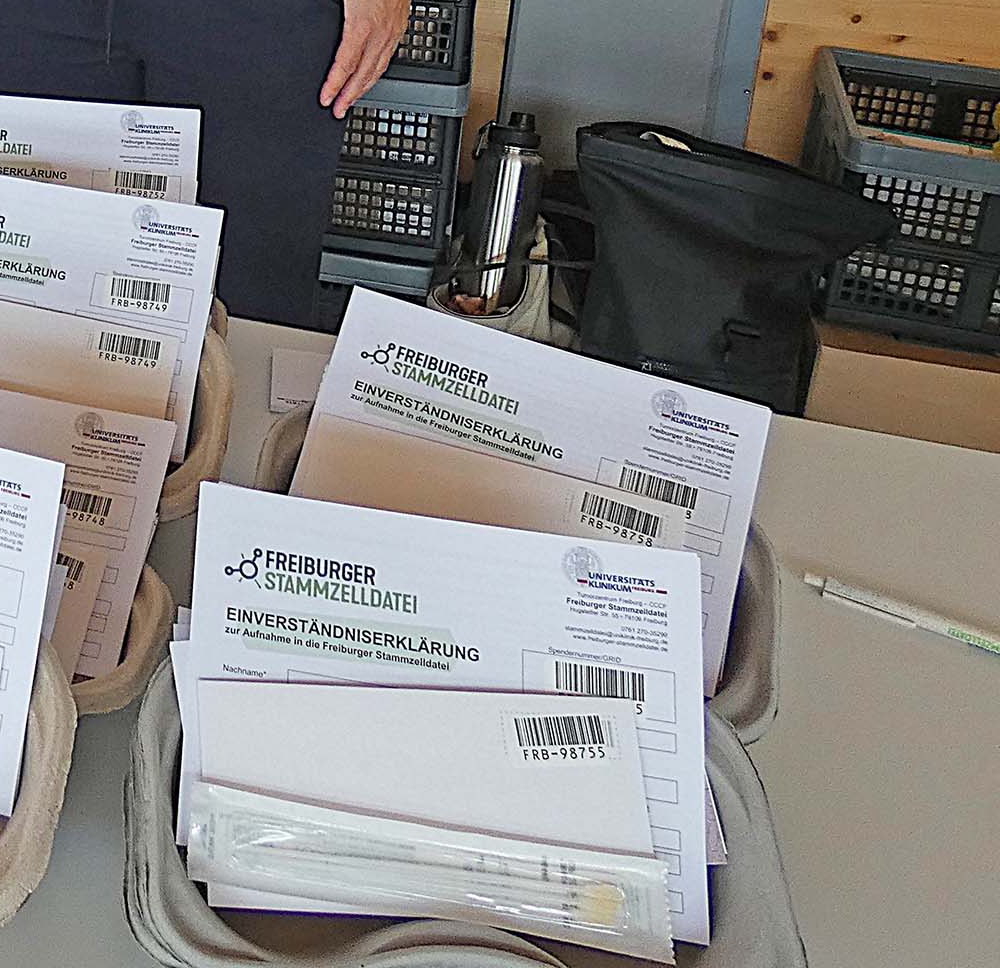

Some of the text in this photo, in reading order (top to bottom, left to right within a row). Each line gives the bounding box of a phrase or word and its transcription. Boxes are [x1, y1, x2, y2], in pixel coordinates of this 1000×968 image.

[111, 298, 168, 312] FRB-98749
[98, 350, 157, 369] FRB-98749
[396, 346, 488, 388] FREIBURGER
[391, 362, 520, 416] STAMMZELLDATEI
[350, 393, 535, 462] zur Aufnahme in die Freiburger Stammzelldatei
[354, 380, 564, 460] EINVERSTÄNDNISERKLÄRUNG
[649, 425, 683, 440] Freiburger
[580, 515, 653, 547] FRB-98758
[265, 550, 376, 586] FREIBURGER
[588, 580, 632, 592] KLINIKUM
[264, 571, 418, 614] STAMMZELLDATEI
[567, 597, 668, 618] Freiburger Stammzelldatei
[224, 625, 450, 671] zur Aufnahme in die Freiburger Stammzelldatei
[226, 607, 480, 662] EINVERSTÄNDNISERKLÄRUNG
[523, 746, 606, 761] FRB-98755
